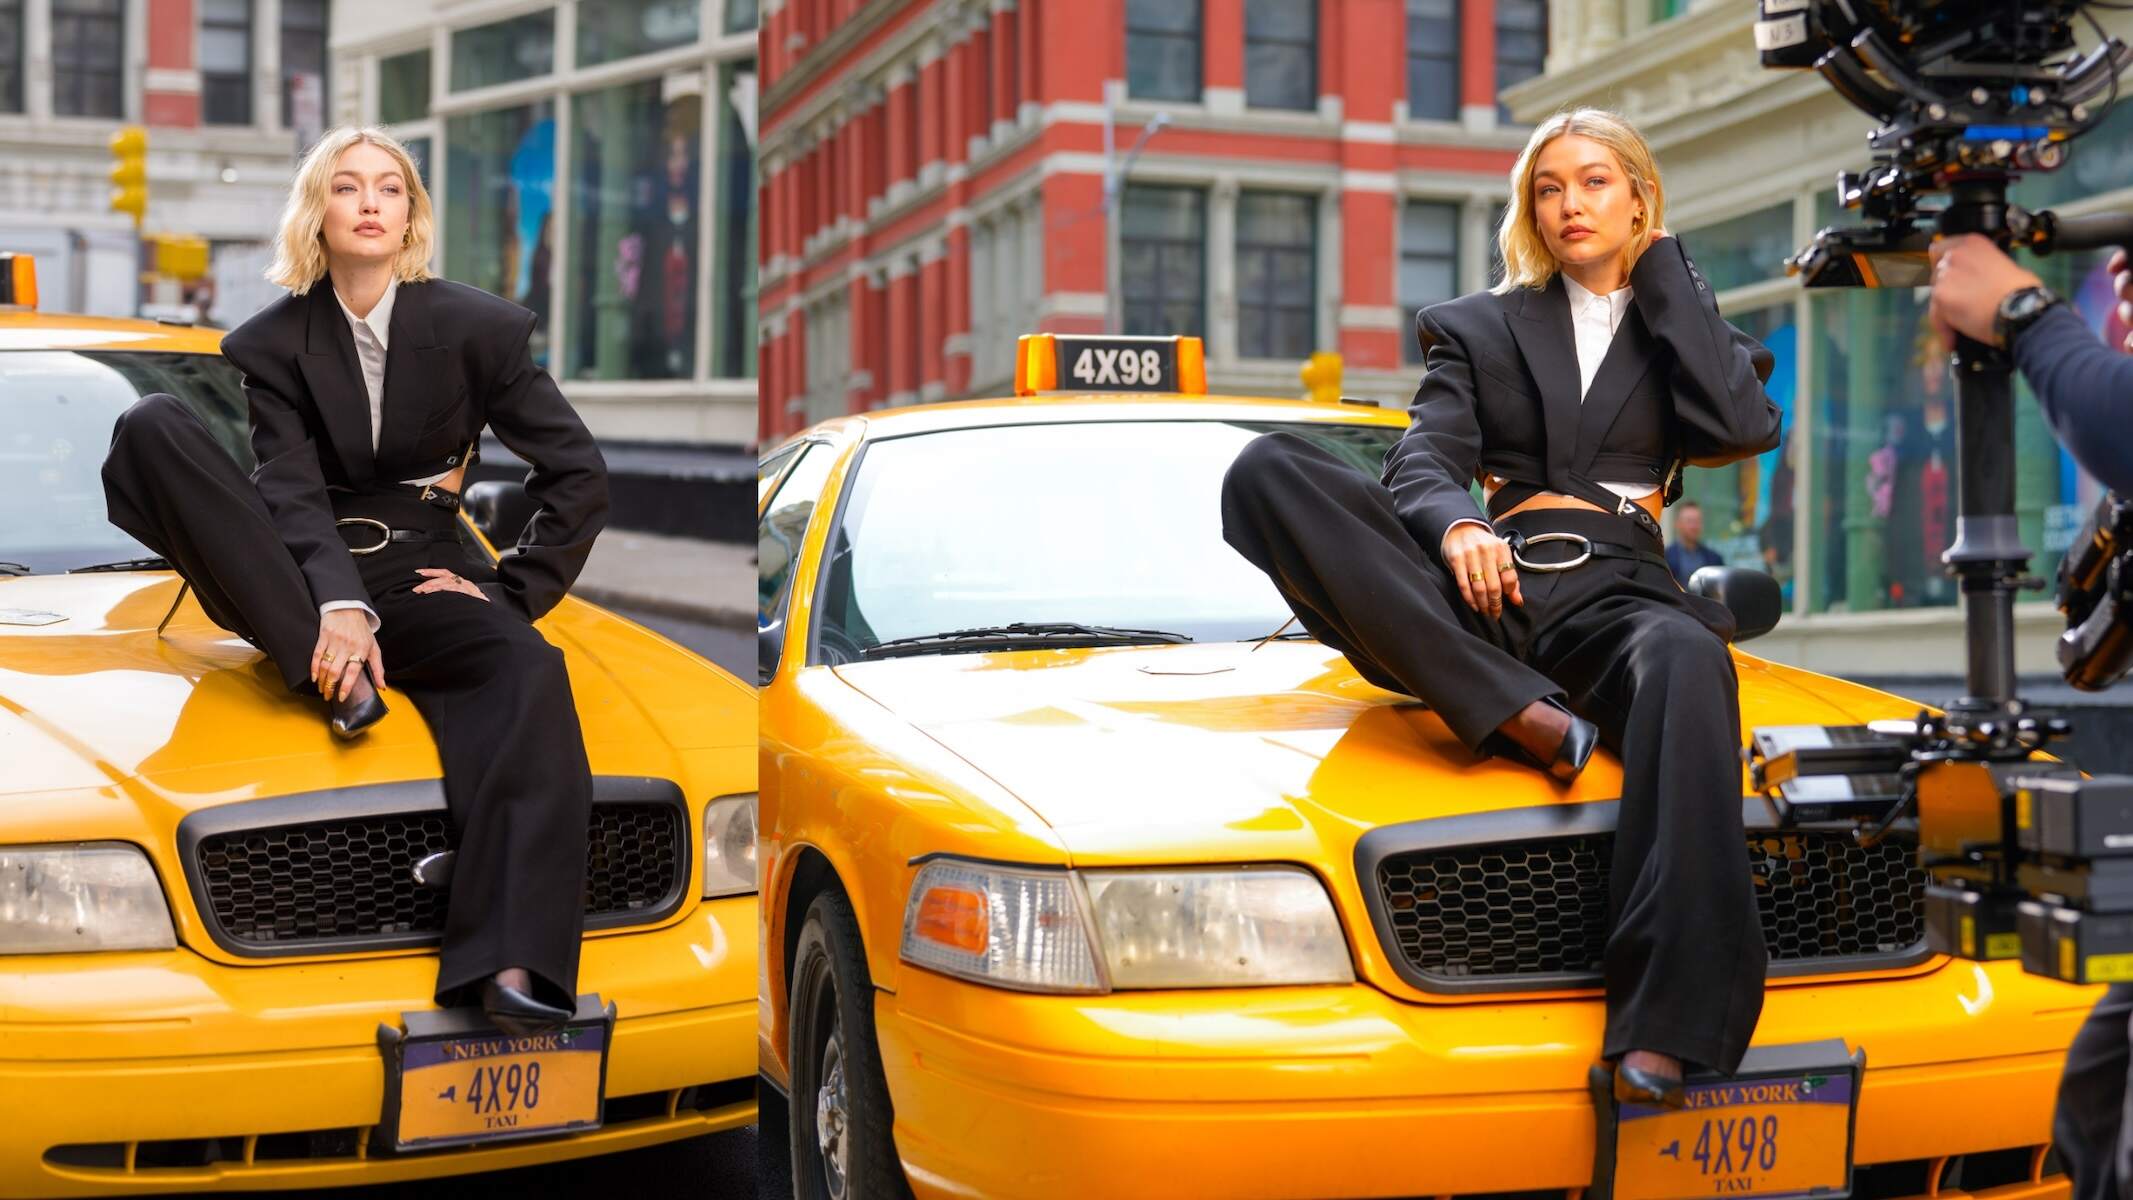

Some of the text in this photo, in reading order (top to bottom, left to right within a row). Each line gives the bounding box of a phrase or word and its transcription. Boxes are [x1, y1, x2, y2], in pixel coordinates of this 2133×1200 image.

[1073, 348, 1161, 385] 4X98
[453, 1035, 558, 1059] NEW YORK
[466, 1061, 541, 1114] 4X98
[1684, 1083, 1800, 1108] NEW YORK
[484, 1114, 518, 1129] TAXI
[1692, 1115, 1778, 1175] 4X98
[1713, 1177, 1752, 1192] TAXI
